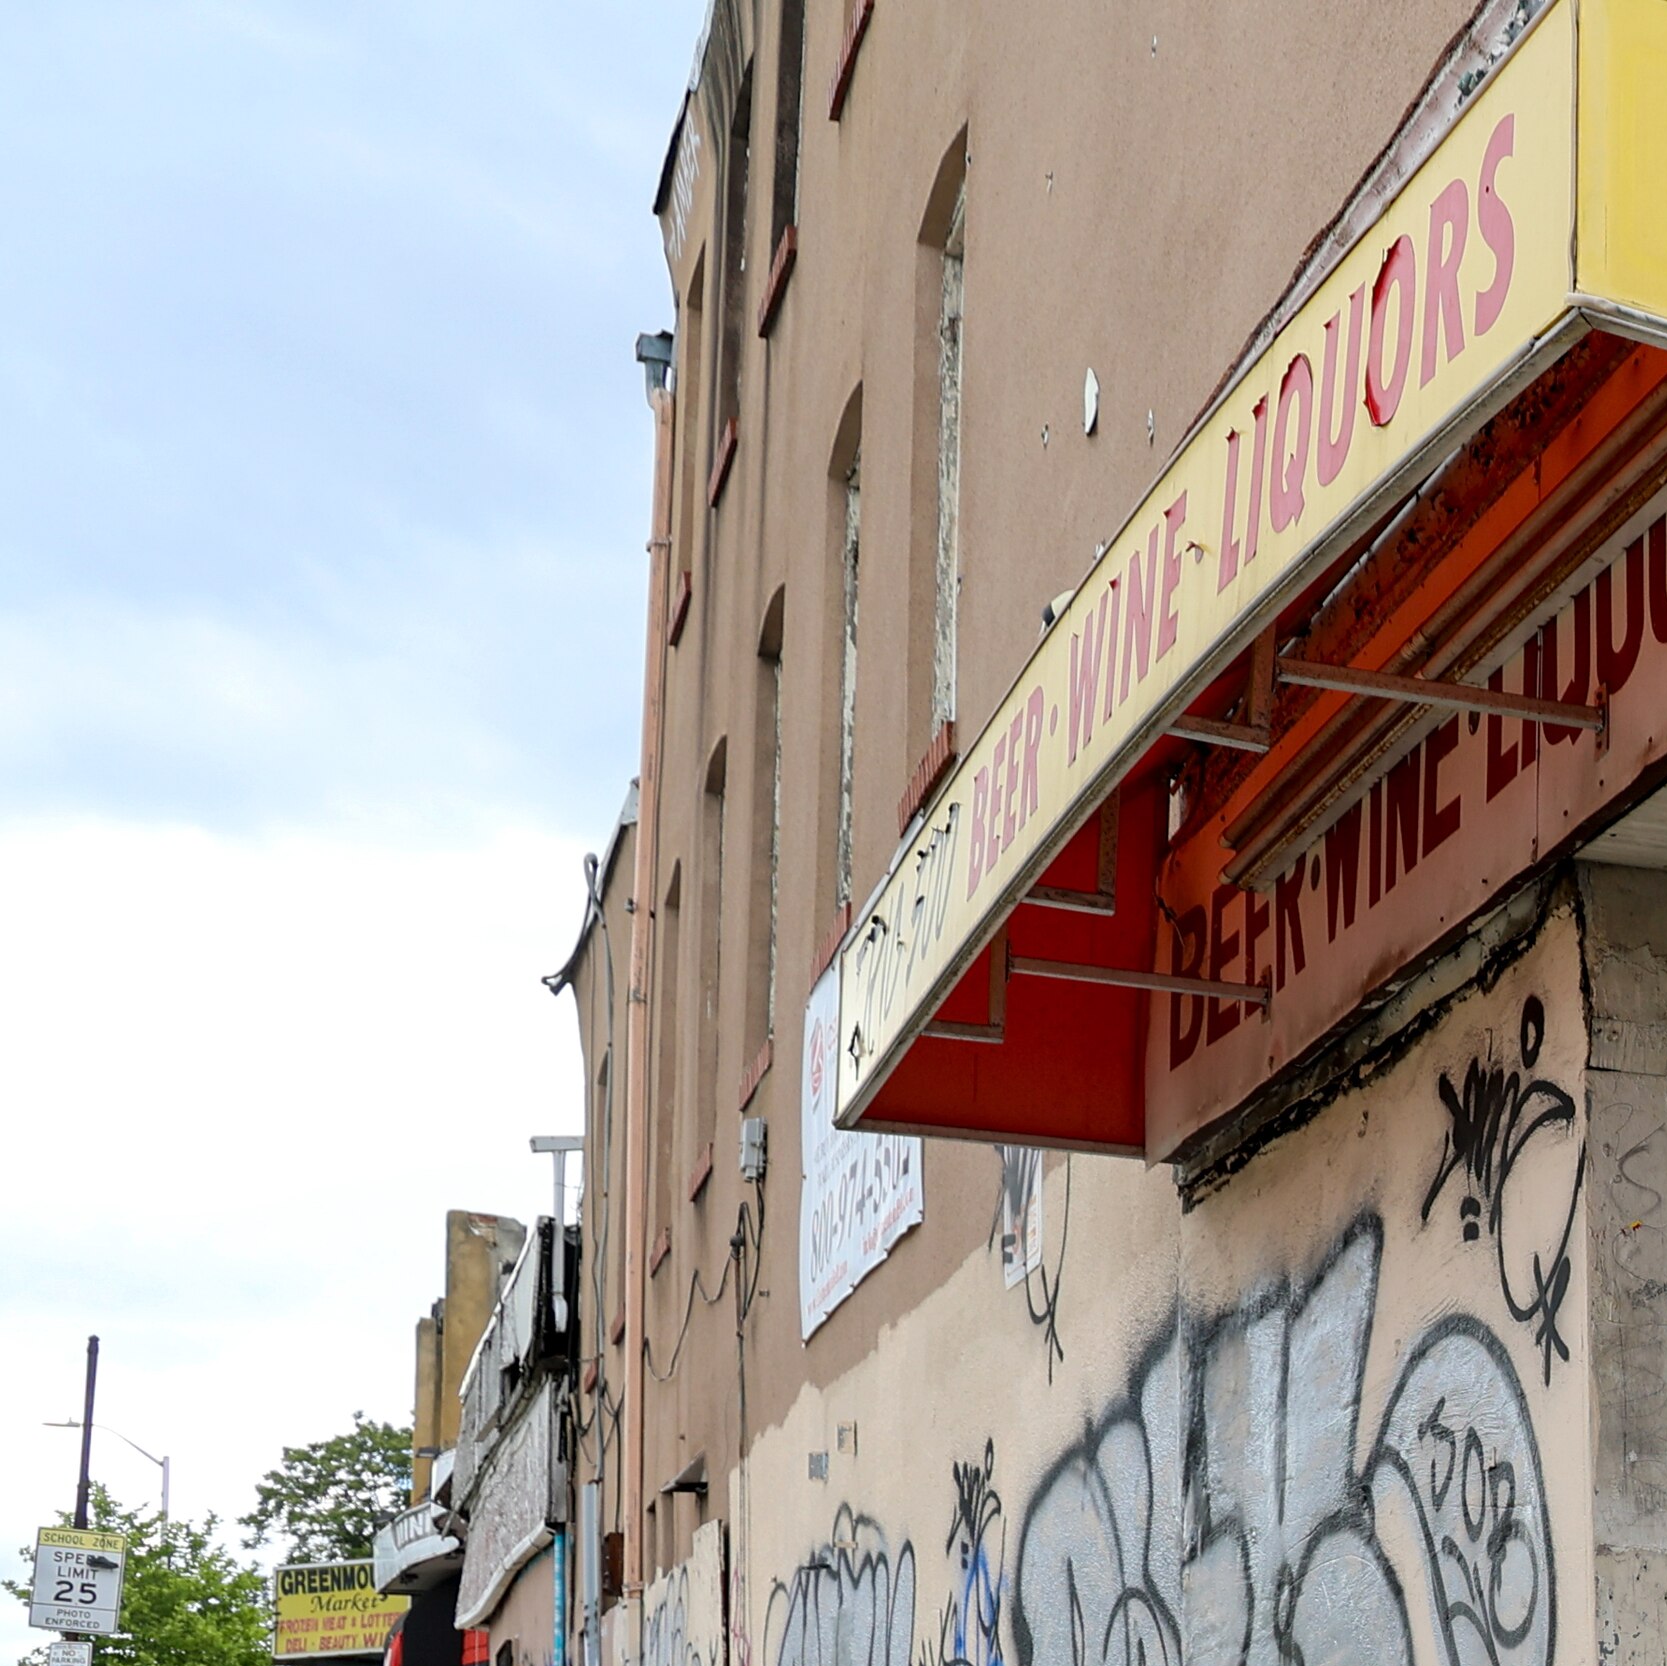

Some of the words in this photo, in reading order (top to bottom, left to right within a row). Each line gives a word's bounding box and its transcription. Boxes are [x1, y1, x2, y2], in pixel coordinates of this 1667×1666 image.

[966, 685, 1045, 903] BEER
[1066, 488, 1188, 768] WINE
[1216, 112, 1516, 596] LIQUORS
[1169, 852, 1307, 1073] BEER
[1322, 720, 1462, 945] WINE
[43, 1531, 86, 1546] SCHOOL
[92, 1537, 120, 1550] ZONE
[53, 1551, 97, 1564] SPE
[57, 1565, 99, 1581] LIMIT
[53, 1580, 98, 1605] 25
[56, 1608, 92, 1619] PHOTO
[44, 1617, 101, 1630] ENFORCED
